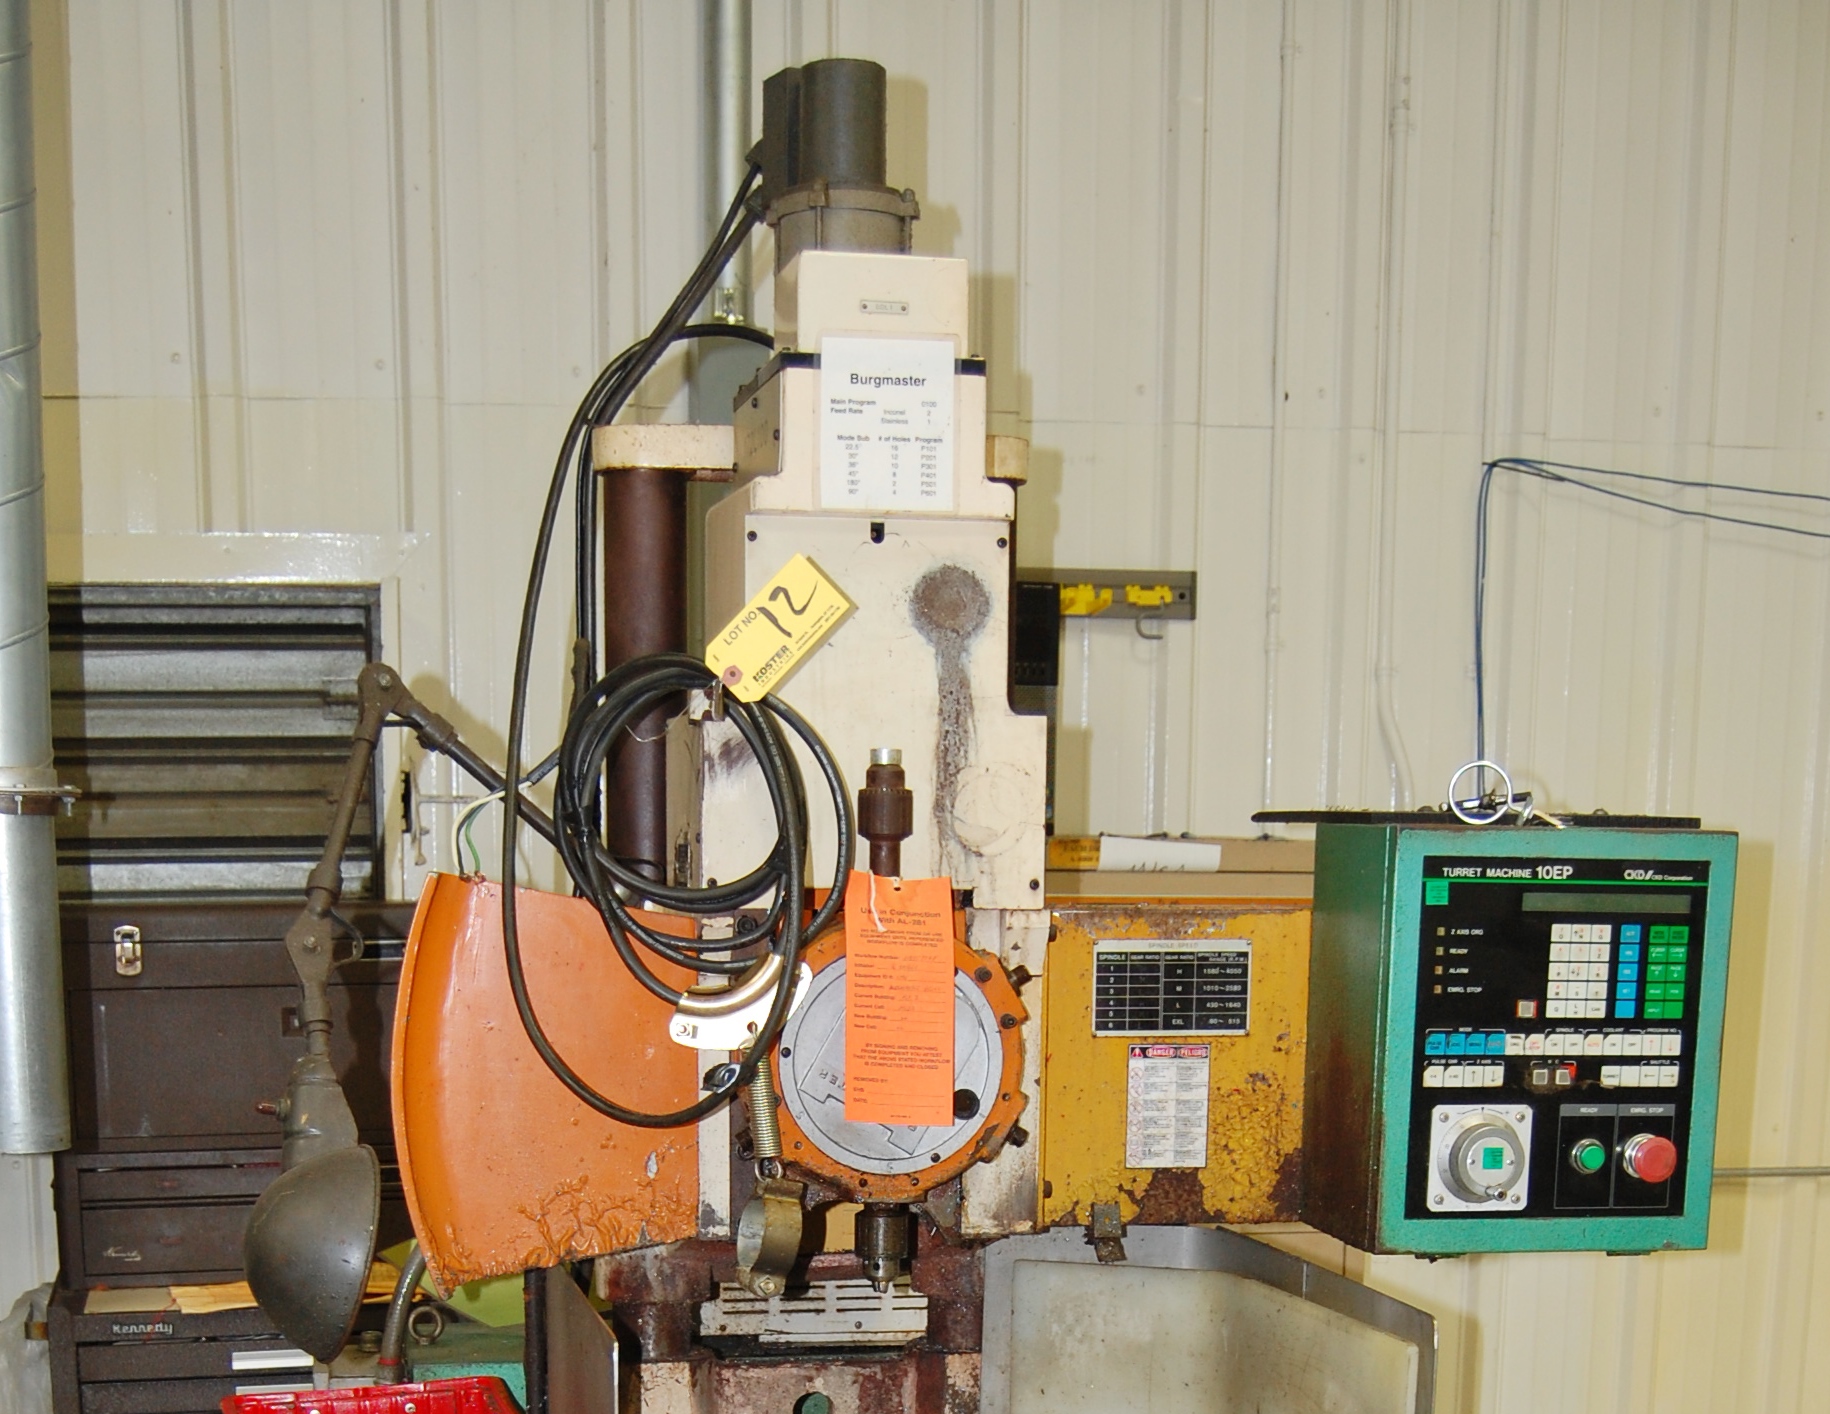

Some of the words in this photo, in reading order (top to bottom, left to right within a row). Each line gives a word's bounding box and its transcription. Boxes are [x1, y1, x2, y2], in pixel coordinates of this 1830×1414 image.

[850, 374, 926, 388] Burgmaster
[756, 580, 818, 638] 12
[723, 624, 744, 646] LOT
[752, 645, 790, 682] KOSTER
[1442, 868, 1482, 878] TURRET
[1486, 868, 1532, 878] MACHINE
[1536, 866, 1573, 880] 10EP
[890, 909, 941, 917] Conjunction
[112, 1323, 174, 1336] Kennedy
